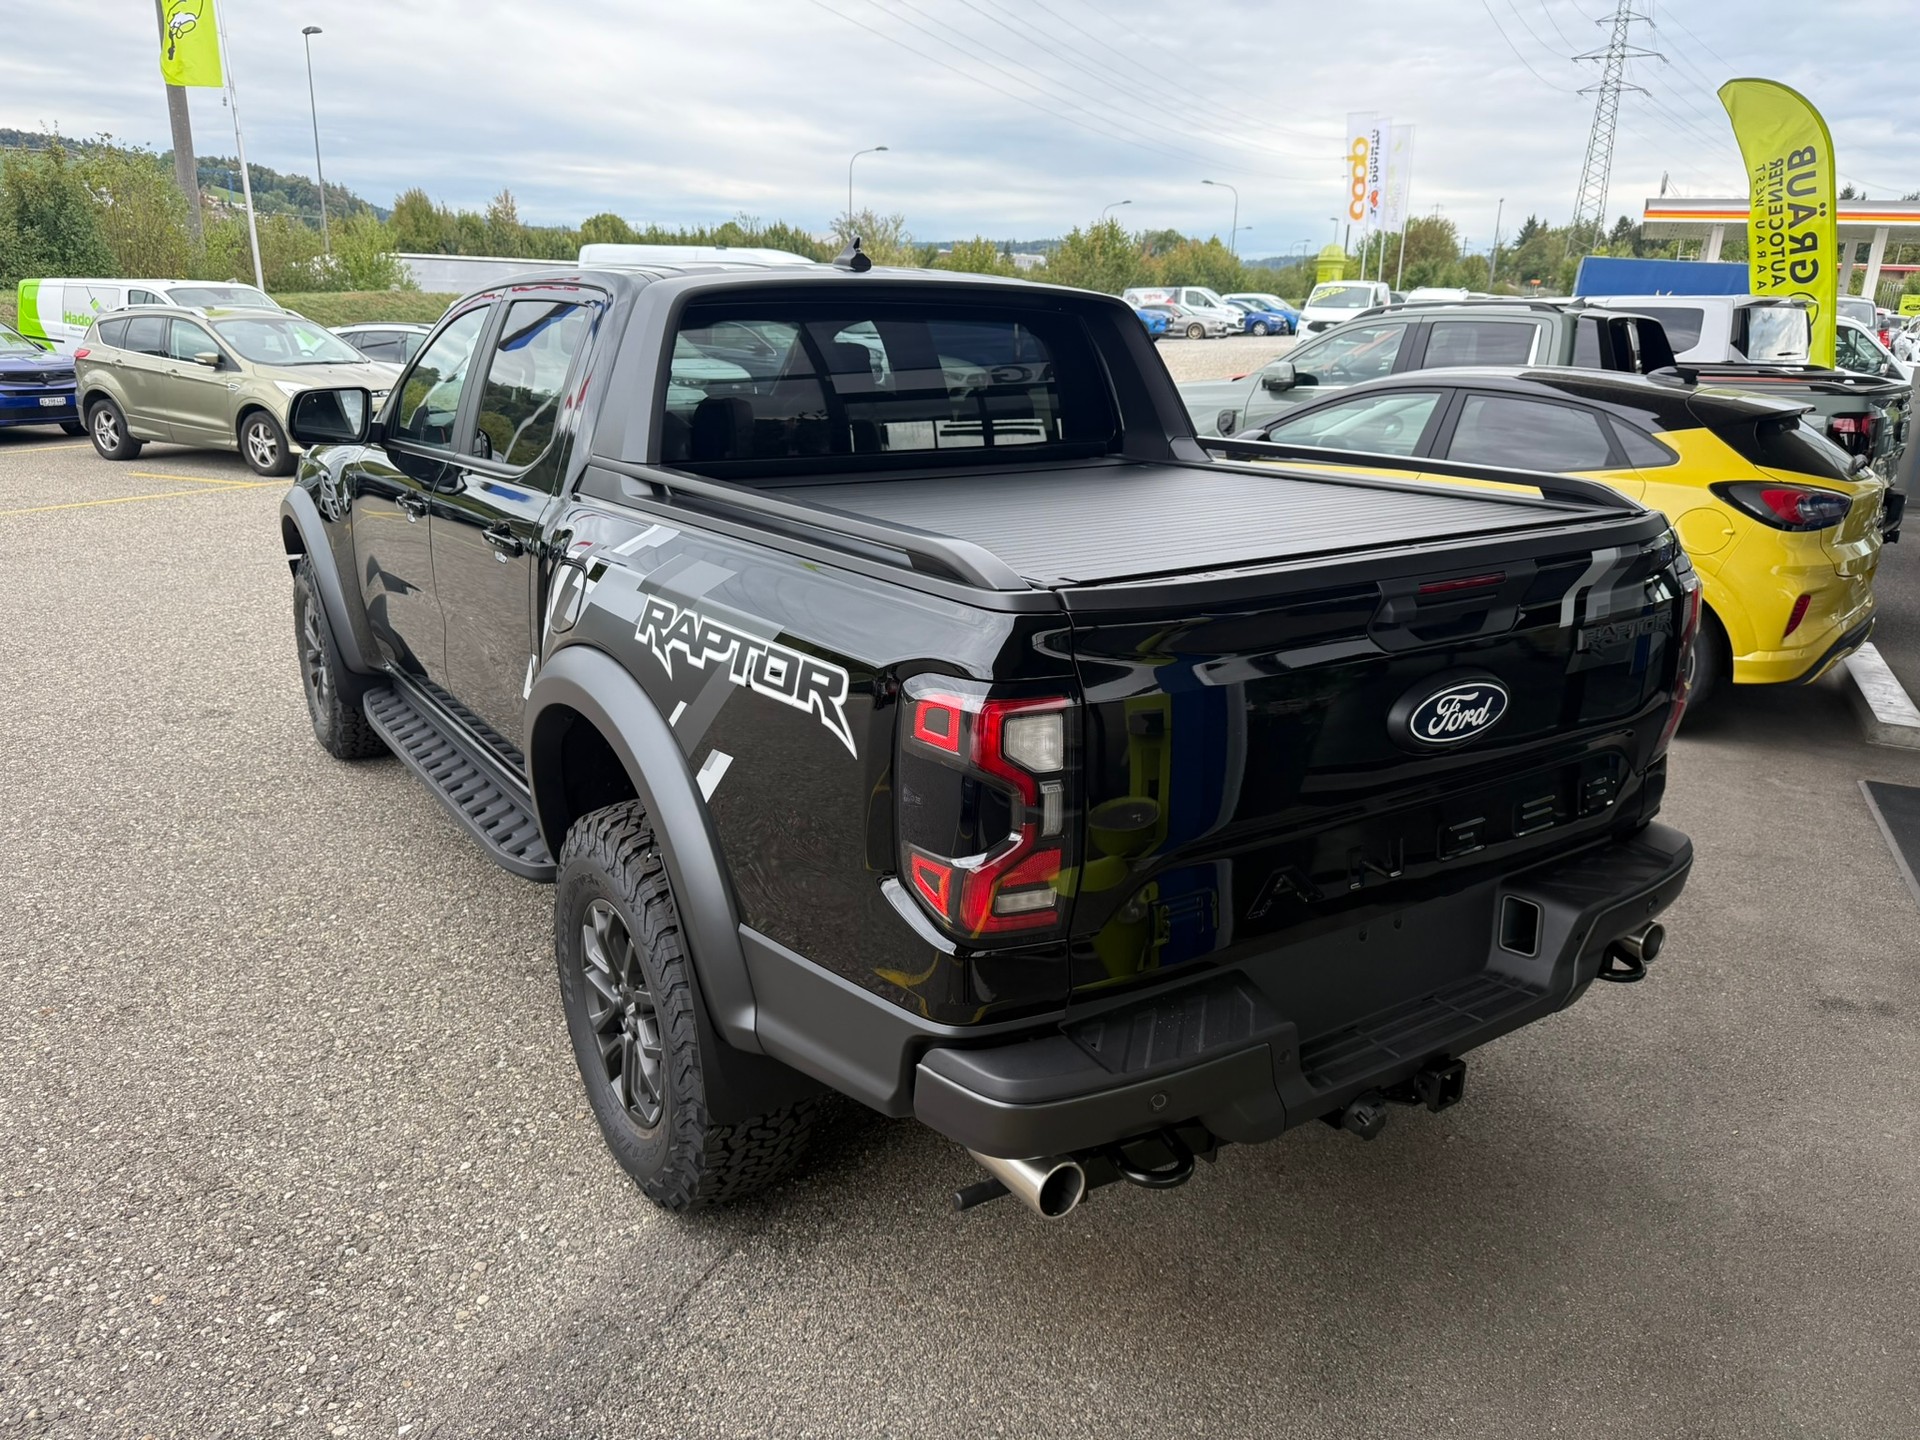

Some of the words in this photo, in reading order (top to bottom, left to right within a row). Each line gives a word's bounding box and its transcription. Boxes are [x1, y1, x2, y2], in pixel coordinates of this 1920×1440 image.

[1577, 609, 1673, 658] RAPTOR
[634, 593, 858, 760] RAPTOR
[1427, 691, 1494, 736] Ford
